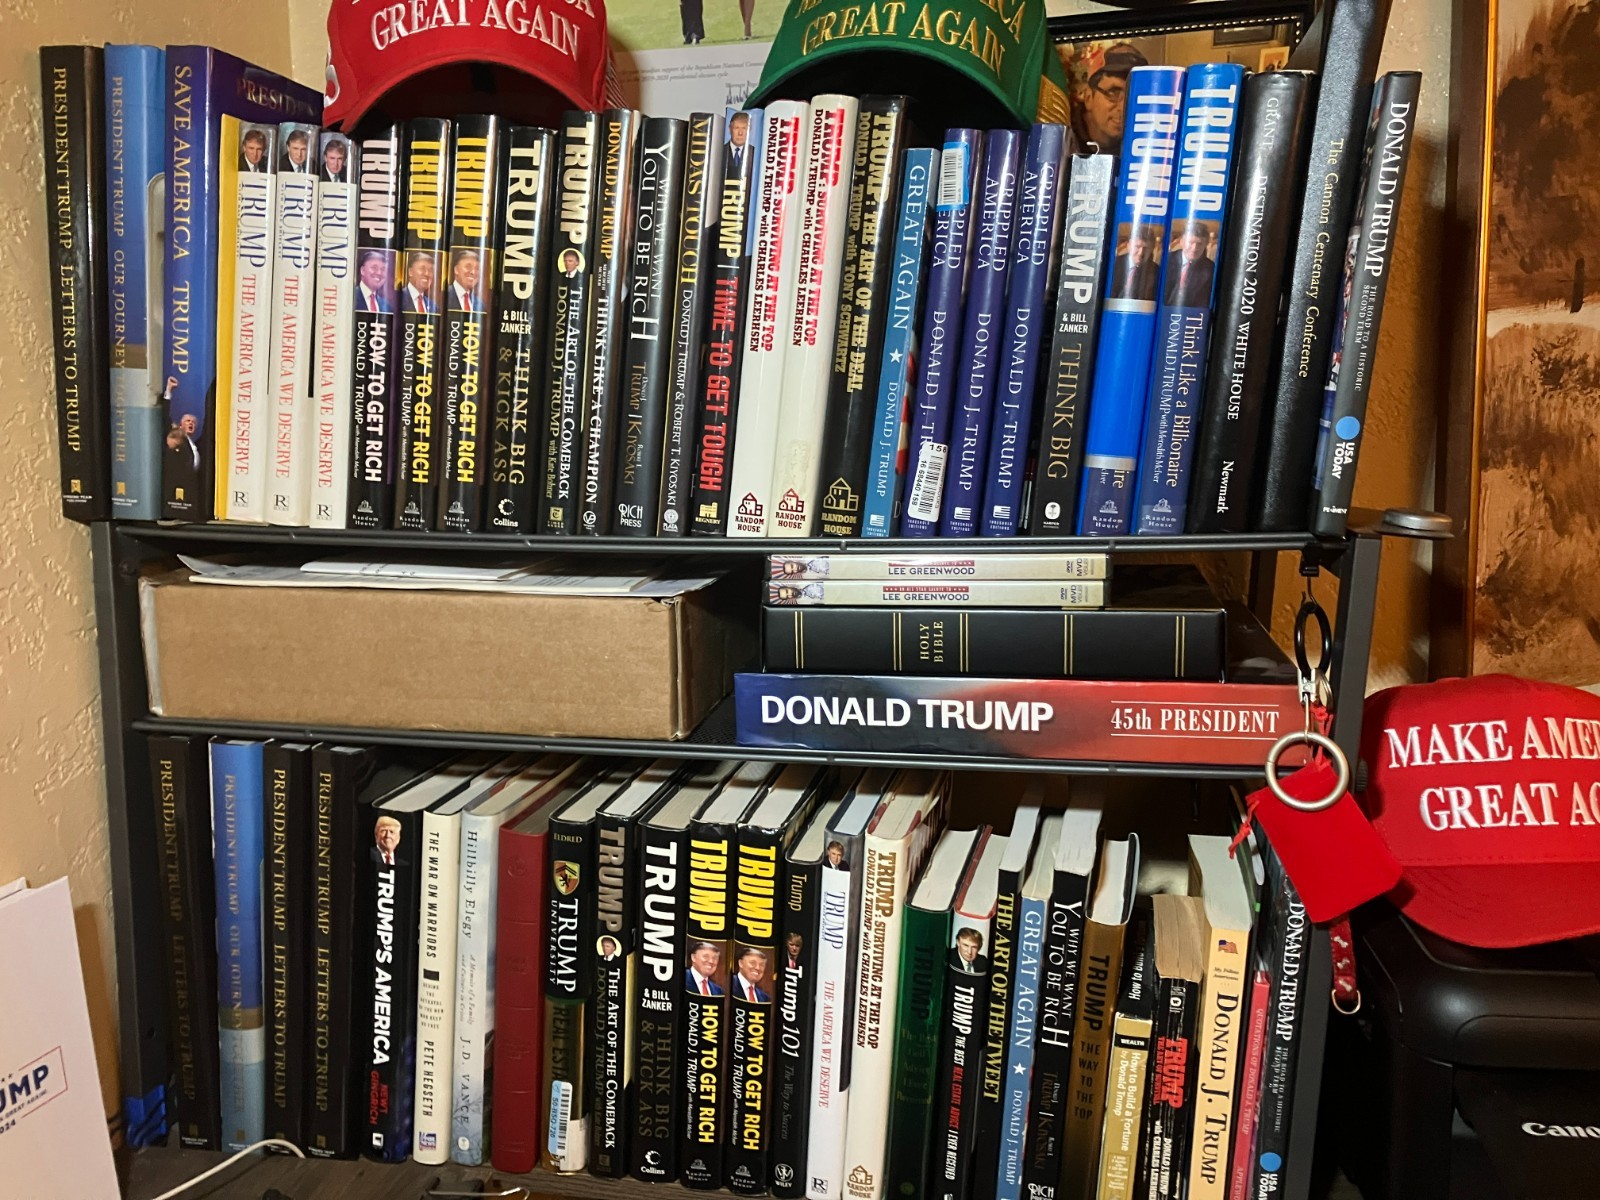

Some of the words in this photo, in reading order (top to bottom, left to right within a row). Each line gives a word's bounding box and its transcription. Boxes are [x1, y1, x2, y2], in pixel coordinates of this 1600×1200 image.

[371, 0, 470, 50] GREAT
[480, 0, 581, 61] AGAIN
[801, 2, 906, 56] GREAT
[908, 2, 1006, 79] AGAIN
[54, 66, 70, 178] PRESIDENT
[174, 65, 192, 131] SAVE
[112, 76, 124, 173] PRESIDENT
[818, 108, 845, 189] TRUMP:
[1178, 84, 1237, 212] TRUMP
[1377, 102, 1410, 196] DONALD
[642, 143, 672, 191] YOU
[866, 112, 898, 206] TRUMP:
[1125, 91, 1182, 217] TRUMP
[1328, 138, 1344, 165] The
[173, 138, 191, 260] AMERICA
[359, 137, 398, 240] TRUMP
[454, 137, 490, 237] TRUMP
[560, 121, 595, 245] TRUMP
[902, 165, 926, 247] GREAT
[1318, 172, 1340, 225] Cannon
[57, 184, 72, 248] TRUMP
[113, 178, 124, 238] TRUMP
[240, 178, 267, 268] TRUMP
[503, 140, 542, 300] TRUMP
[638, 202, 654, 231] TO
[718, 178, 747, 258] TRUMP
[811, 191, 830, 265] SURVIVING
[862, 211, 878, 245] THE
[1017, 170, 1038, 264] AMERICA
[1031, 165, 1055, 266] CRIPPLED
[1246, 175, 1268, 274] DESTINATION
[636, 241, 650, 266] BE
[1063, 173, 1103, 304] TRUMP
[1364, 198, 1395, 278] TRUMP
[114, 250, 125, 285] OUR
[241, 274, 256, 306] THE
[810, 267, 822, 286] AT
[858, 248, 876, 283] ART
[1305, 232, 1330, 300] Centenary
[60, 265, 76, 348] LETTERS
[568, 287, 583, 320] THE
[631, 276, 660, 342] RICH
[712, 277, 738, 332] TIME
[806, 288, 821, 316] THE
[856, 286, 873, 311] OF
[892, 253, 916, 330] AGAIN
[1240, 276, 1258, 316] 2020
[114, 291, 126, 369] JOURNEY
[172, 281, 190, 373] TRUMP
[500, 323, 532, 335] ZANKER
[503, 311, 509, 321] &
[510, 311, 530, 322] BILL
[596, 298, 609, 350] THINK
[804, 317, 819, 346] TOP
[852, 313, 870, 348] THE
[1180, 312, 1204, 359] Think
[64, 353, 78, 380] TO
[239, 314, 255, 376] AMERICA
[356, 321, 367, 372] DONALD
[370, 322, 387, 366] HOW
[567, 326, 580, 360] ART
[710, 340, 734, 367] TO
[1233, 321, 1251, 370] WHITE
[1298, 306, 1320, 378] Conference
[238, 380, 252, 403] WE
[356, 373, 364, 381] J.
[368, 373, 385, 396] TO
[512, 348, 531, 434] THINK
[565, 361, 578, 380] OF
[592, 355, 605, 395] LIKE
[706, 374, 730, 416] GET
[847, 352, 866, 393] DEAL
[1052, 342, 1082, 430] THINK
[1176, 360, 1198, 397] Like
[66, 384, 80, 451] TRUMP
[355, 384, 364, 425] TRUMP
[366, 401, 385, 436] GET
[563, 383, 575, 414] THE
[591, 399, 602, 411] A
[1174, 398, 1188, 409] a
[1227, 372, 1244, 421] HOUSE
[235, 409, 250, 475] DESERVE
[365, 441, 383, 482] RICH
[510, 443, 526, 485] BIG
[558, 418, 575, 500] COMEBACK
[586, 415, 602, 504] CHAMPION
[700, 423, 726, 491] TOUGH
[1046, 436, 1072, 480] BIG
[1166, 415, 1192, 488] Billionaire
[1332, 442, 1346, 480] TODAY
[1343, 441, 1356, 465] USA
[1216, 460, 1235, 514] Newmark
[494, 518, 518, 528] Collins
[822, 512, 858, 524] RANDOM
[824, 524, 852, 535] HOUSE
[888, 567, 906, 575] LEE
[909, 567, 975, 575] GREENWOOD
[919, 622, 930, 661] HOLY
[934, 620, 944, 664] BIBLE
[760, 695, 912, 728] DONALD
[917, 698, 1054, 732] TRUMP
[1110, 707, 1152, 731] 45th
[1160, 708, 1280, 734] PRESIDENT
[1384, 720, 1513, 769] MAKE
[1420, 782, 1560, 832] GREAT
[429, 832, 440, 853] THE
[464, 830, 478, 894] Hillbilly
[554, 832, 583, 844] ELDRED
[428, 856, 439, 880] WAR
[428, 884, 438, 898] ON
[598, 826, 626, 932] TRUMP
[689, 840, 728, 932] TRUMP
[736, 844, 777, 938] TRUMP
[375, 870, 395, 965] TRUMP'S
[642, 841, 678, 982] TRUMP
[790, 874, 808, 912] Trump
[996, 892, 1014, 931] THE
[426, 903, 438, 958] WARRIORS
[462, 900, 476, 940] Elegy
[550, 900, 558, 984] UNIVERSITY
[1282, 902, 1306, 976] DONALD
[557, 898, 579, 993] TRUMP
[993, 932, 1011, 972] ART
[1021, 910, 1042, 980] GREAT
[780, 965, 803, 1022] Trump
[952, 985, 976, 1035] TRUMP
[991, 972, 1008, 1000] OF
[1084, 955, 1110, 1032] TRUMP
[1275, 978, 1298, 1041] TRUMP
[372, 968, 392, 1065] AMERICA
[988, 1001, 1006, 1039] THE
[1014, 984, 1035, 1048] AGAIN
[1210, 991, 1239, 1080] DONALD
[423, 1040, 434, 1068] PETE
[781, 1023, 801, 1059] 101
[1120, 1038, 1144, 1046] WEALTH
[1128, 1052, 1141, 1072] How
[422, 1070, 434, 1117] HEGSETH
[984, 1040, 1005, 1103] TWEET
[1126, 1085, 1138, 1106] Build
[1130, 1073, 1138, 1083] to
[1200, 1082, 1230, 1104] J.
[459, 1074, 470, 1124] VANCE
[1120, 1118, 1134, 1152] Fortune
[1200, 1112, 1228, 1185] TRUMP
[775, 1180, 792, 1188] WILEY
